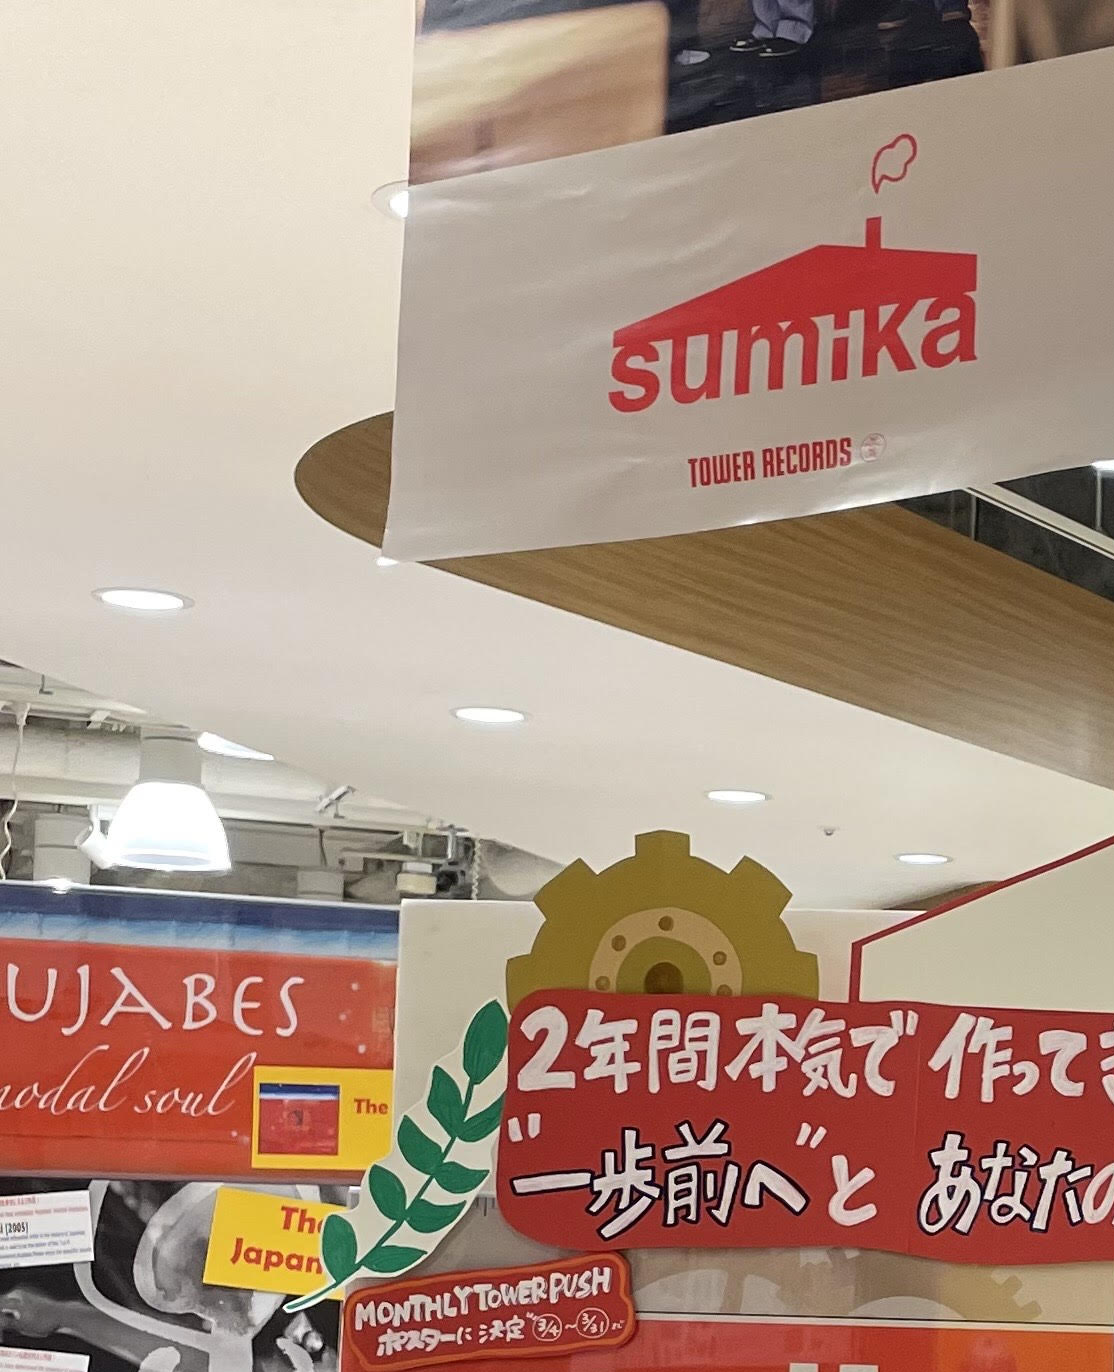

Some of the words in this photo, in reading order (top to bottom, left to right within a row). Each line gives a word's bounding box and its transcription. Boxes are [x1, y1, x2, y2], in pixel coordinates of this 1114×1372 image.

[608, 290, 978, 413] sumika
[688, 449, 755, 488] TOWER
[763, 437, 851, 482] RECORDS
[7, 963, 303, 1036] UJABES
[517, 1003, 919, 1098] 2年間本気で
[134, 1052, 257, 1116] soul
[354, 1098, 388, 1114] The
[354, 1286, 470, 1330] MONTHLY
[473, 1277, 548, 1311] TOWER
[550, 1267, 611, 1304] PUSH
